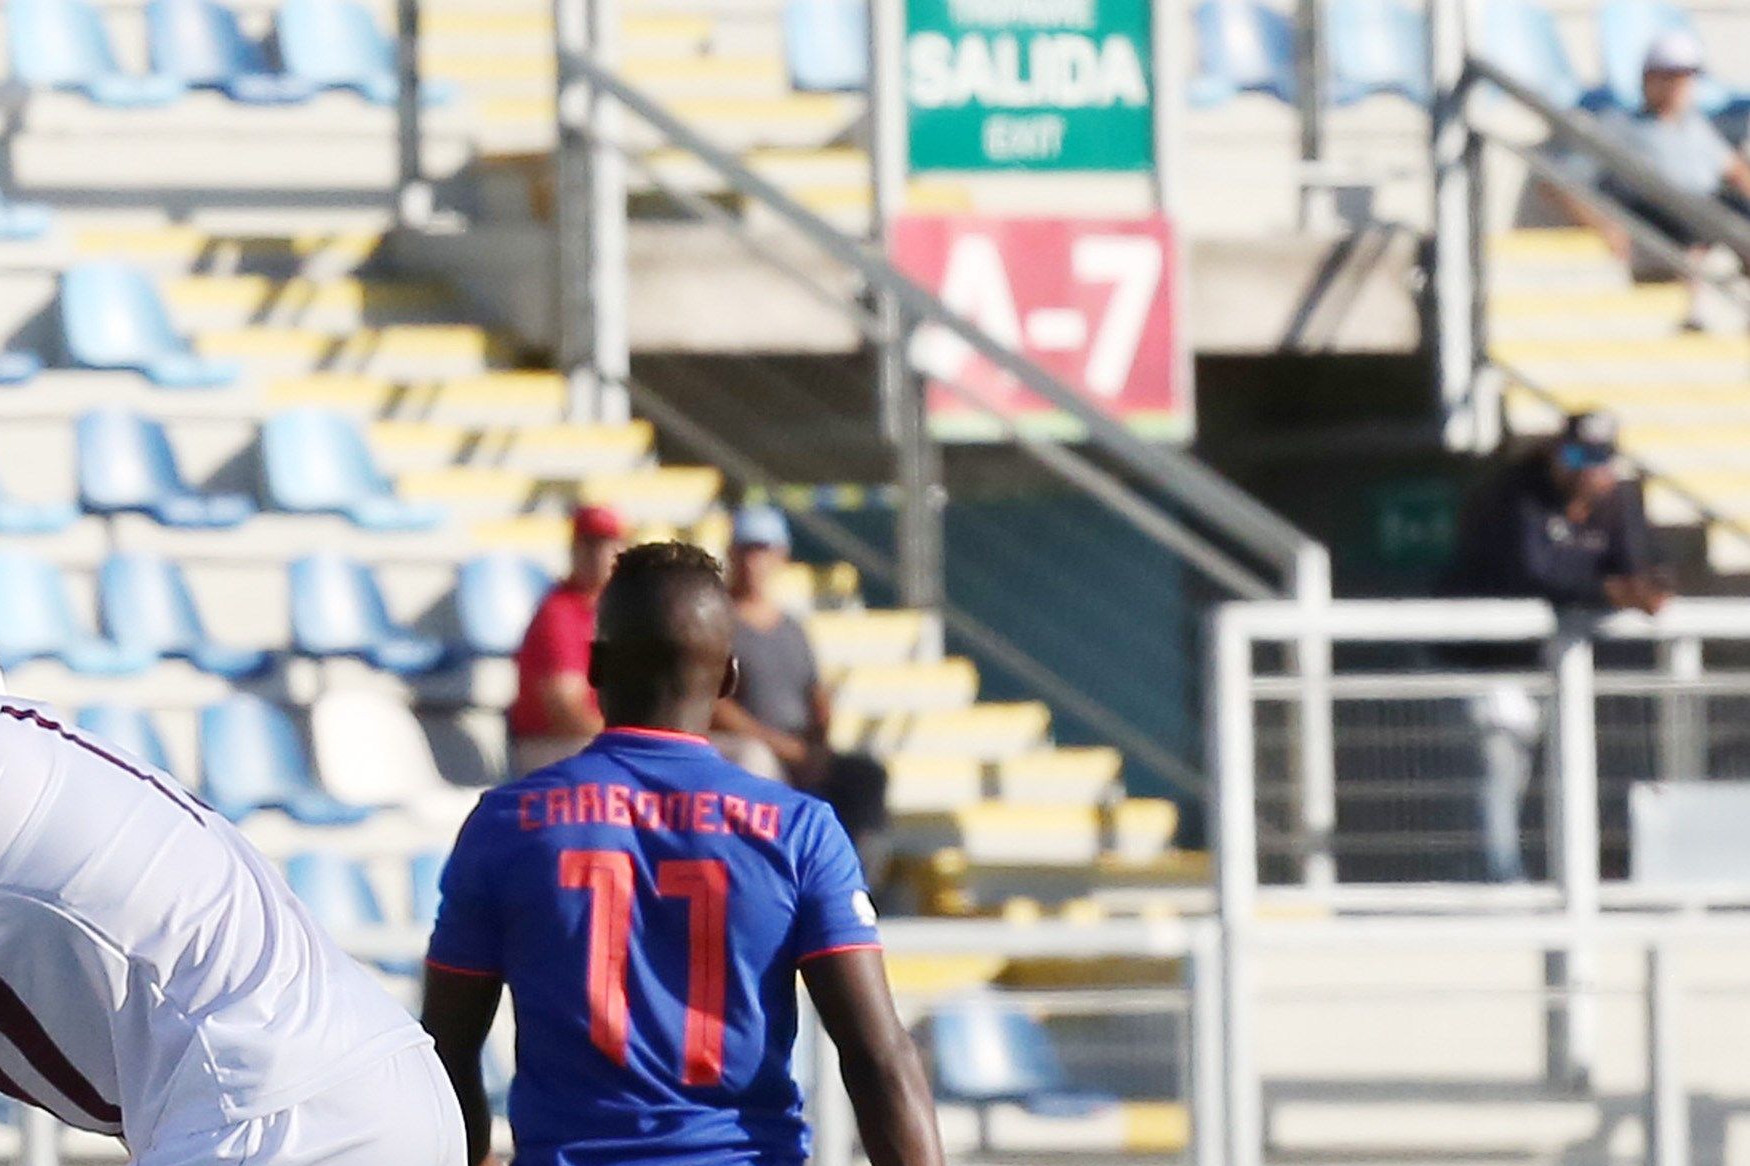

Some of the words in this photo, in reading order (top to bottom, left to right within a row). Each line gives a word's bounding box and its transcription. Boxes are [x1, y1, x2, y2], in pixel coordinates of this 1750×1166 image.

[906, 31, 1149, 108] SALIDA
[907, 233, 1163, 396] A-7
[518, 782, 780, 842] CARBONERO
